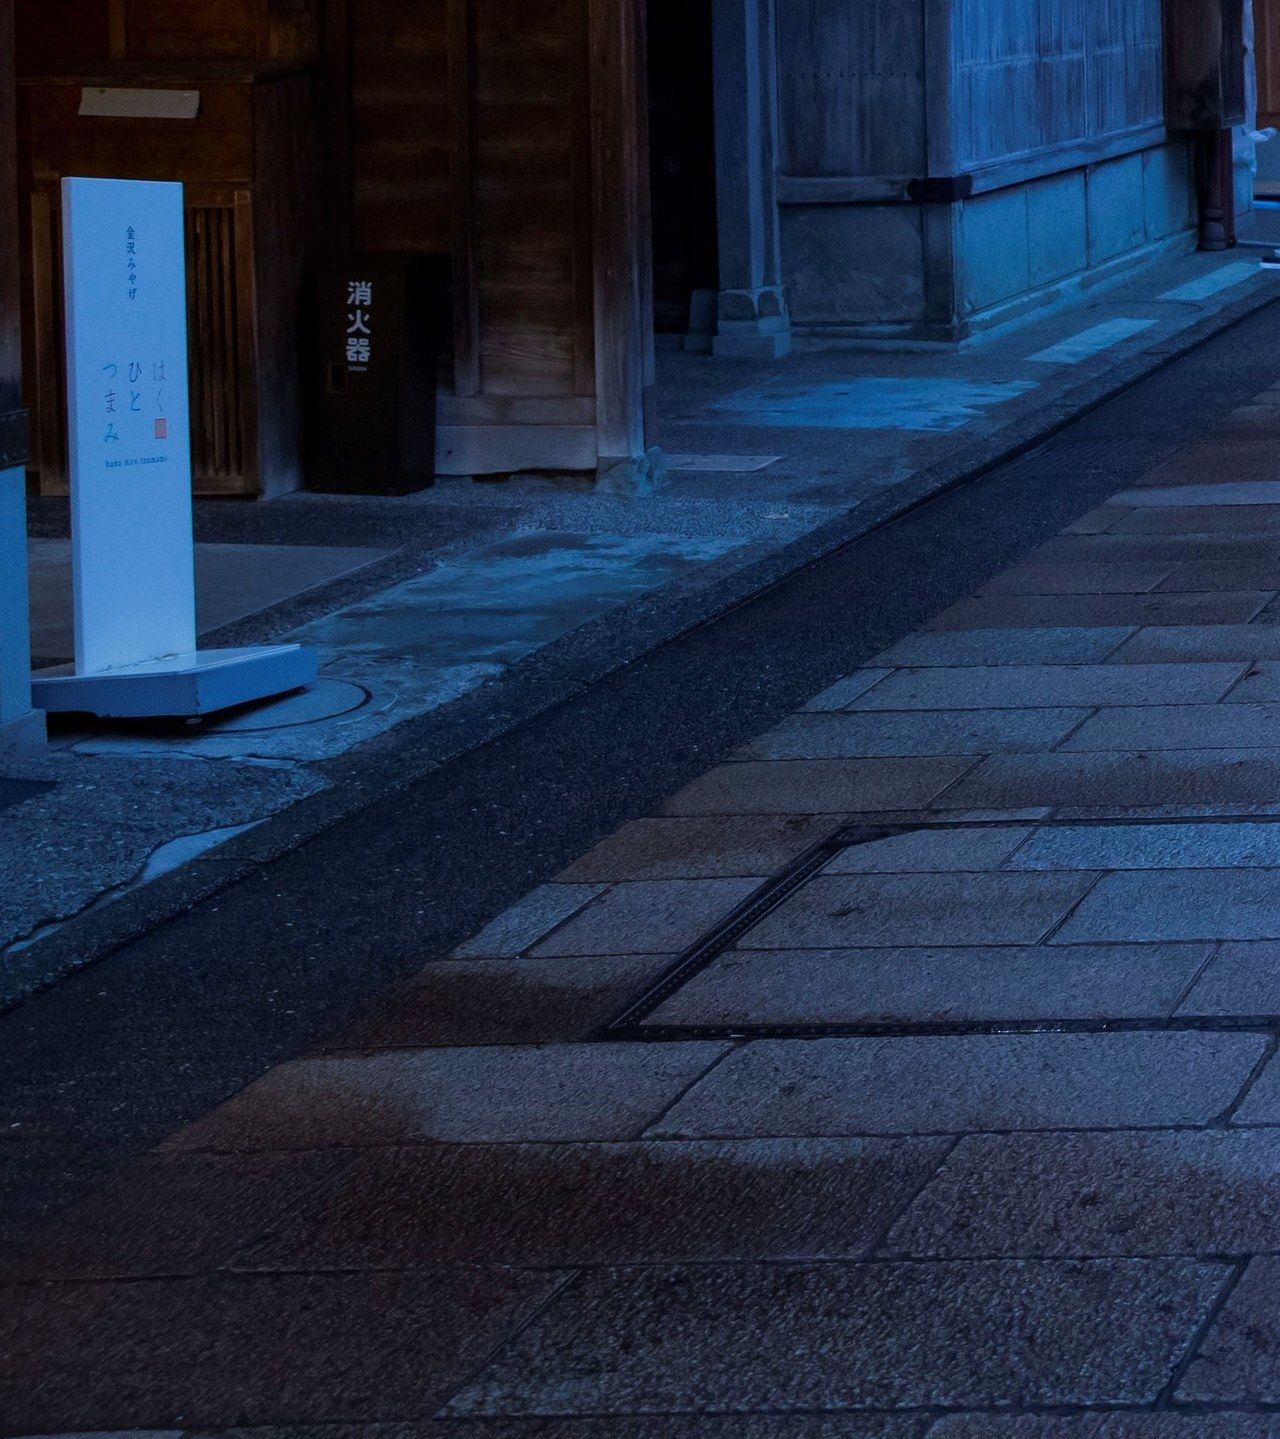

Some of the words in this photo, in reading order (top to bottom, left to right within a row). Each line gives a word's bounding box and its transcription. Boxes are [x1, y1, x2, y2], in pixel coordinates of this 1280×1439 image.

[126, 225, 138, 300] 金沢みやげ
[345, 280, 373, 362] 消火器
[102, 363, 119, 444] つまみ
[128, 361, 142, 412] ひと
[153, 360, 167, 412] はく
